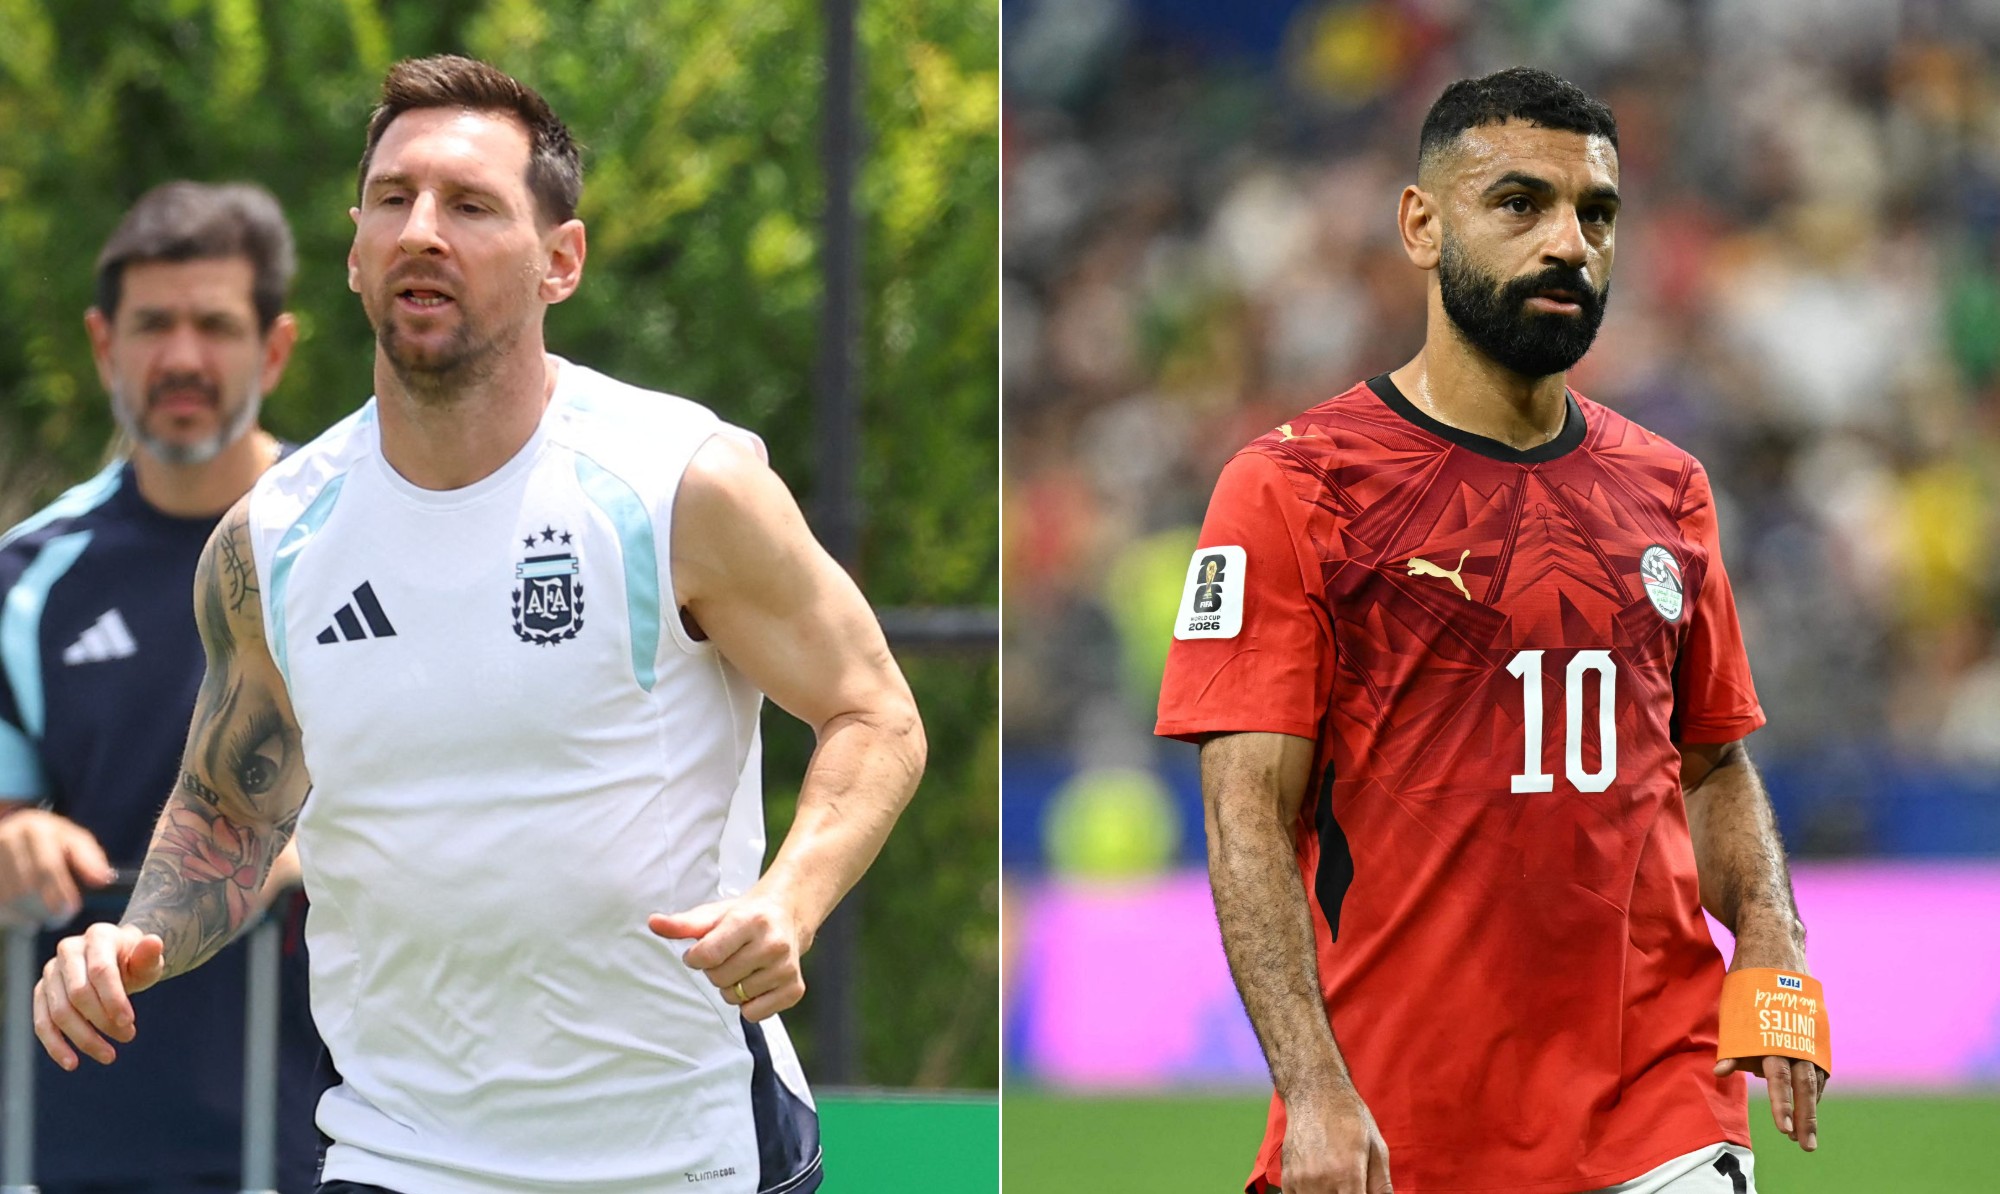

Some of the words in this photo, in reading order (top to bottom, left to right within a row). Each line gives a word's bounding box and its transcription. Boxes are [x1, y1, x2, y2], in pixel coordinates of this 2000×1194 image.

[525, 577, 569, 620] AFA
[1200, 600, 1213, 608] FIFA
[1188, 622, 1220, 631] 2026
[1505, 650, 1617, 794] 10
[1778, 977, 1801, 989] FIFA
[1754, 988, 1798, 1011] World
[1799, 997, 1818, 1015] the
[1759, 1009, 1815, 1039] UNITES
[1760, 1031, 1816, 1055] FOOTBALL
